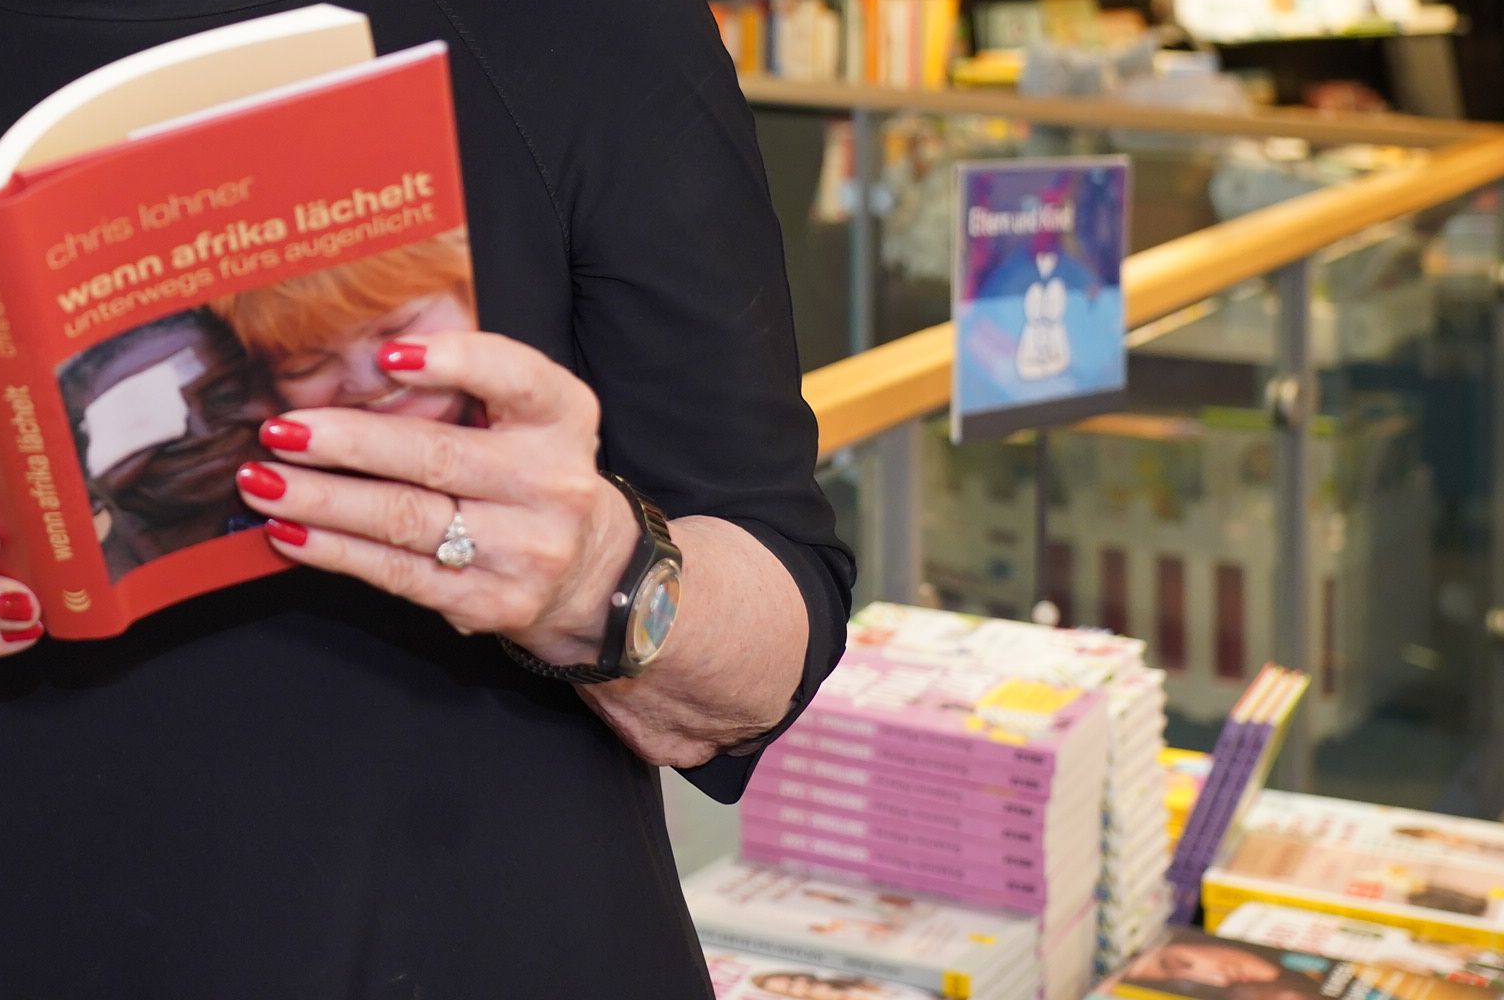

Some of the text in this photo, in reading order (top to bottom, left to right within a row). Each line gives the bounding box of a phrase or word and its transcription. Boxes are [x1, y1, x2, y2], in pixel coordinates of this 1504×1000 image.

[44, 176, 254, 271] chris lohner
[57, 171, 435, 314] wenn afrika lächelt
[63, 201, 436, 339] unterwegs fürs augenlicht
[3, 383, 74, 562] wenn afrika lächelt
